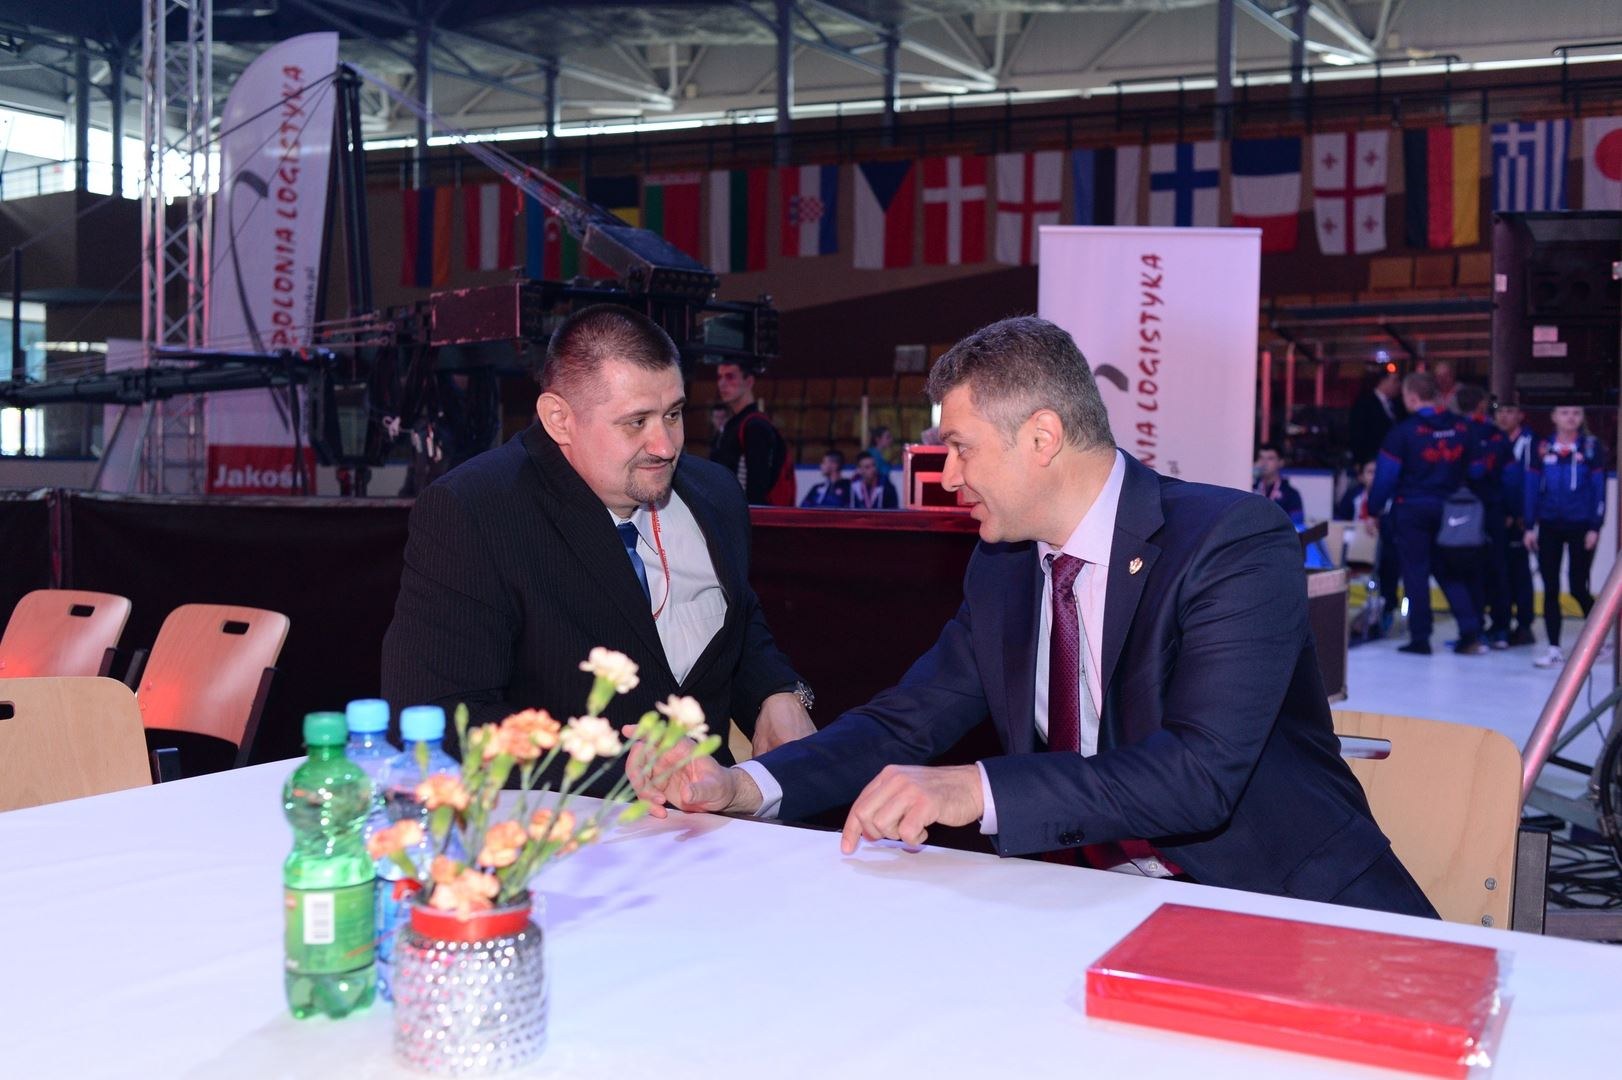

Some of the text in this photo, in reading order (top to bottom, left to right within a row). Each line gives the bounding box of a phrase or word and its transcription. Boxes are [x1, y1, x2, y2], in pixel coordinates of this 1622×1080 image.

[271, 65, 304, 346] POLONIA LOGISTYKA
[1135, 253, 1164, 468] NIA LOGISTYKA
